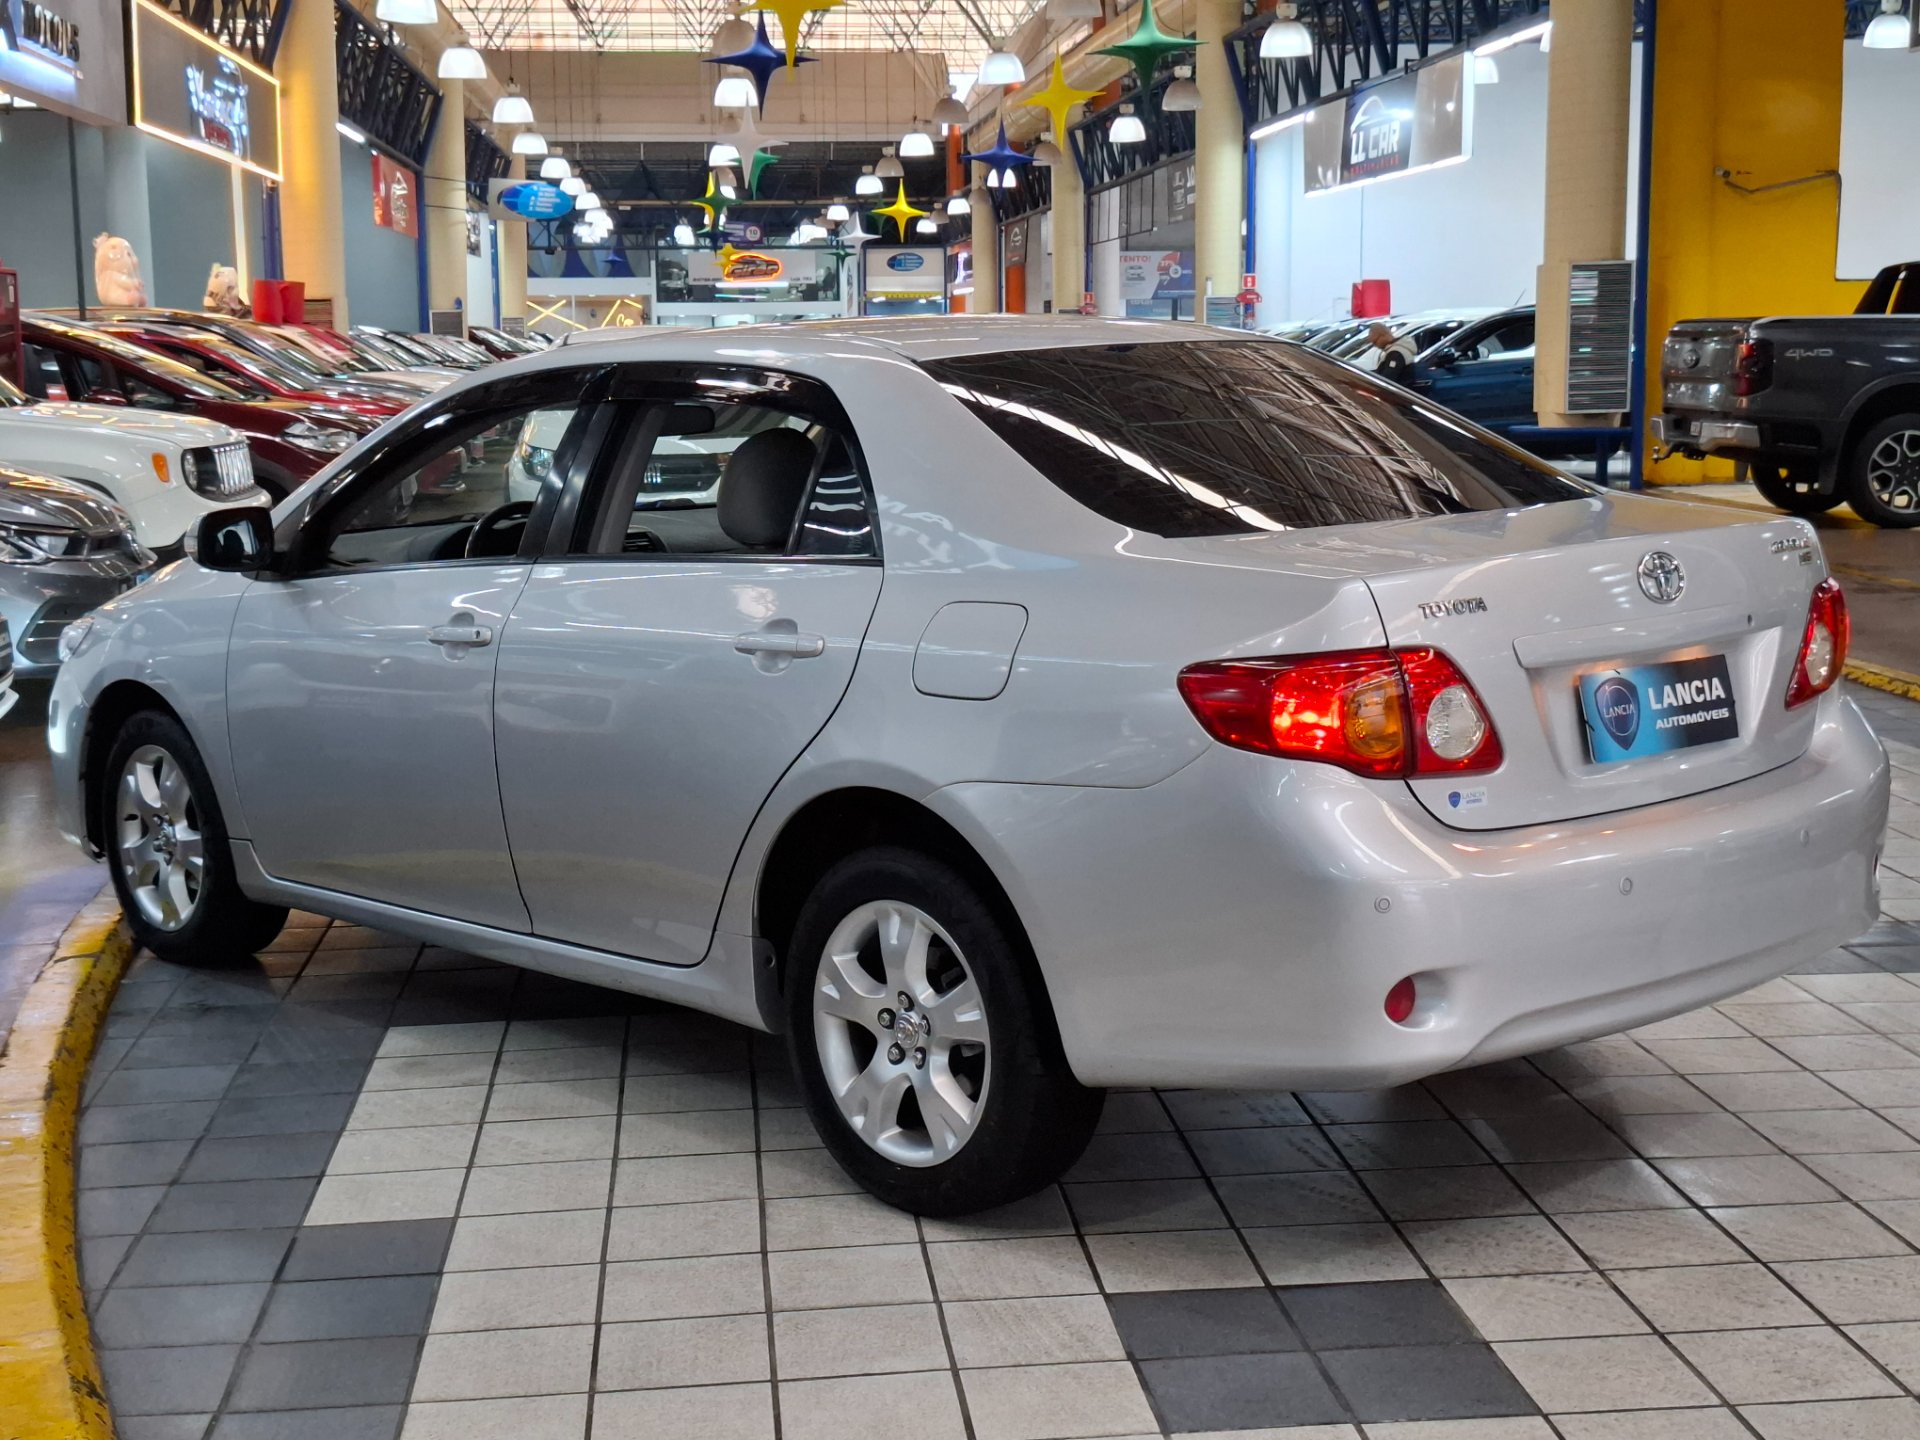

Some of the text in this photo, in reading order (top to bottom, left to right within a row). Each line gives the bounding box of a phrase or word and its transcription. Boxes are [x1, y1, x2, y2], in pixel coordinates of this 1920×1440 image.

[1369, 120, 1400, 159] CAR
[1784, 348, 1833, 360] 4WD
[1418, 597, 1488, 619] TOYOTA
[1648, 677, 1726, 710] LANCIA
[1603, 704, 1636, 718] LANCIA
[1655, 707, 1730, 730] AUTOMÓVEIS
